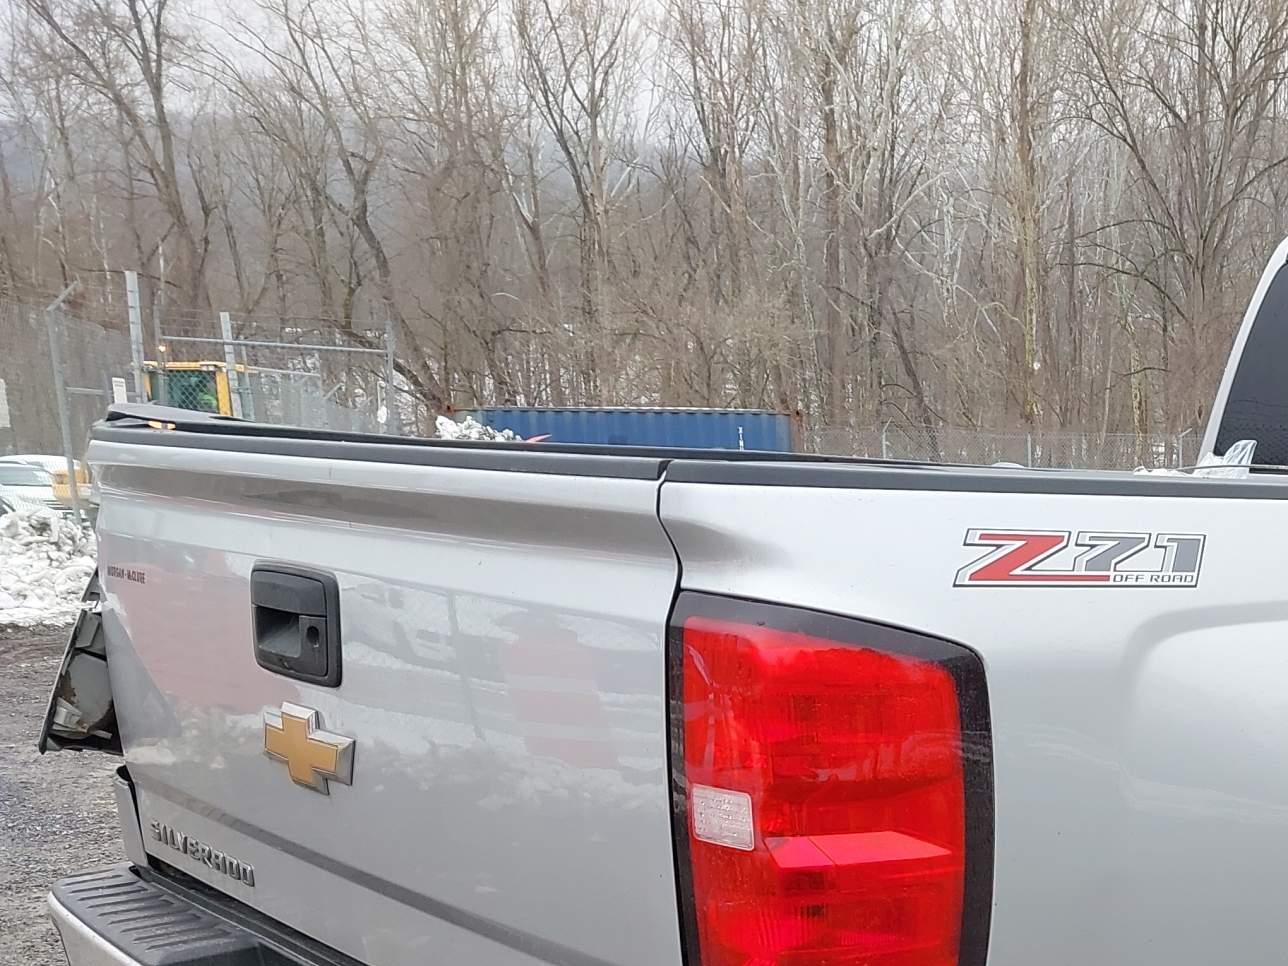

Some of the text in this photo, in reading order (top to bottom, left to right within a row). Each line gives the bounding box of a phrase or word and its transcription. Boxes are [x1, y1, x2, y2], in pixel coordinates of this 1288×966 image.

[953, 528, 1207, 588] Z71
[1112, 574, 1195, 583] OFF ROAD
[150, 819, 255, 888] SILVERADO
